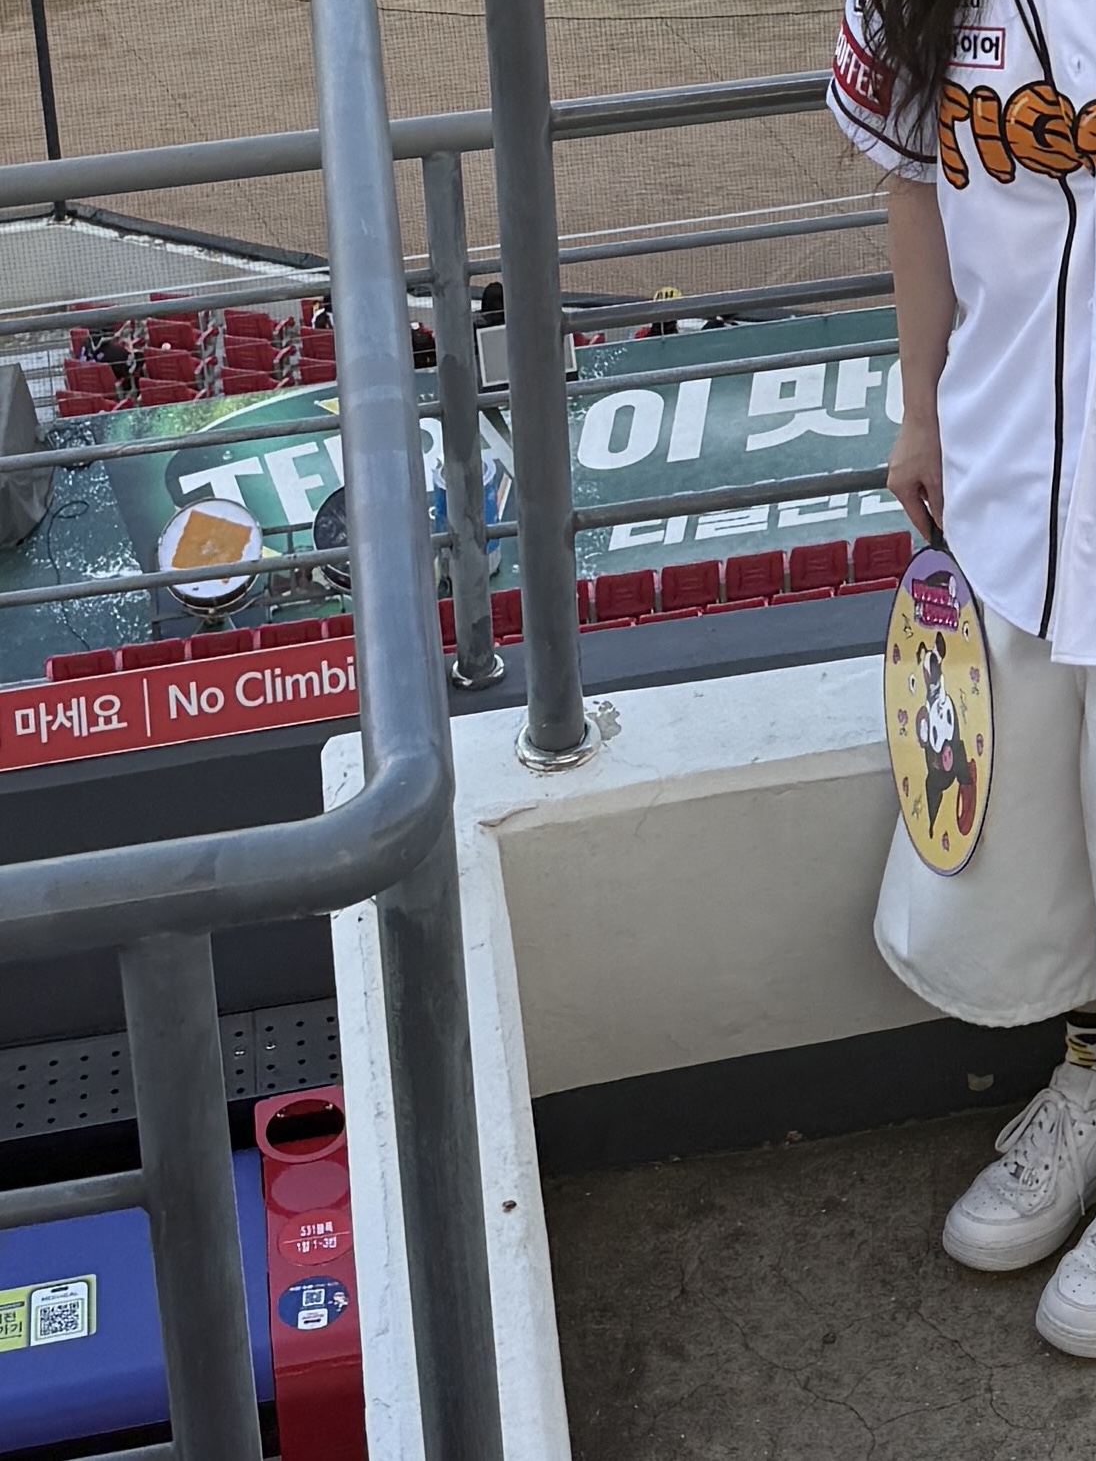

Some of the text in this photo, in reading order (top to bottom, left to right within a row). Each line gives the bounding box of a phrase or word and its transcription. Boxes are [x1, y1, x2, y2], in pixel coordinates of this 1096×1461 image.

[577, 377, 713, 470] 이
[14, 656, 357, 743] 마세요 No Climbi
